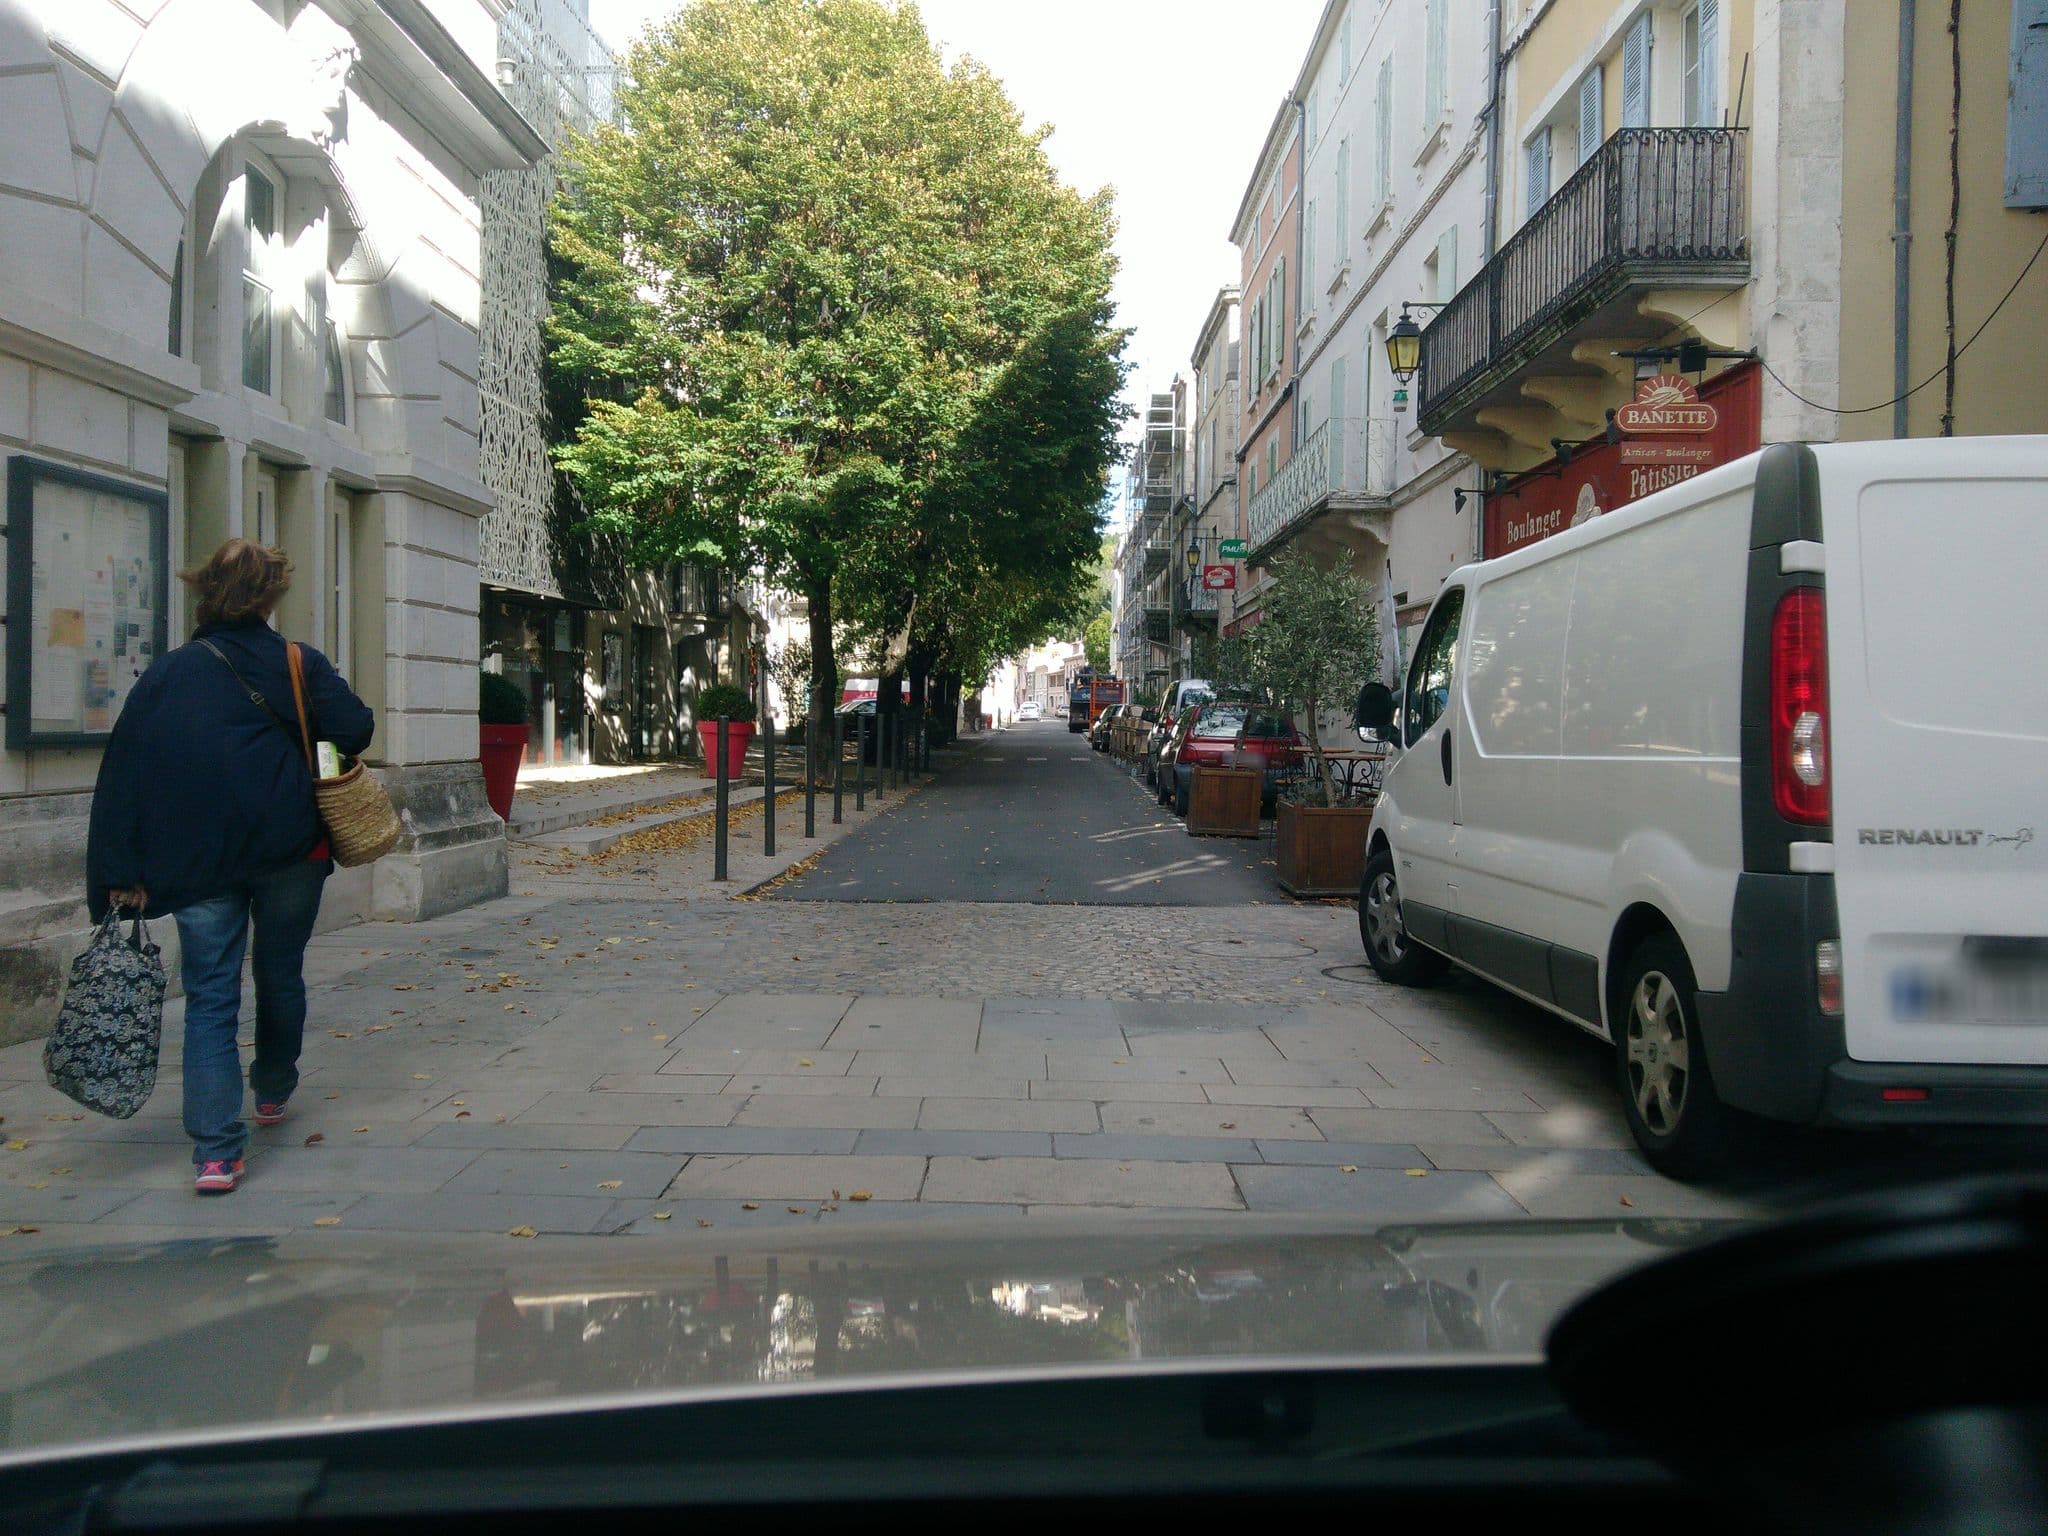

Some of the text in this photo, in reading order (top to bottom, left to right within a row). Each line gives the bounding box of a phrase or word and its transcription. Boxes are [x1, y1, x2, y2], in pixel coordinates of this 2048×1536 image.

[1627, 410, 1708, 424] BANETTE
[1624, 447, 1657, 457] Artisan
[1666, 446, 1711, 461] Boulanger
[1507, 508, 1561, 544] Boulanger
[1221, 545, 1240, 553] PMU
[1857, 829, 1984, 846] RENAULT
